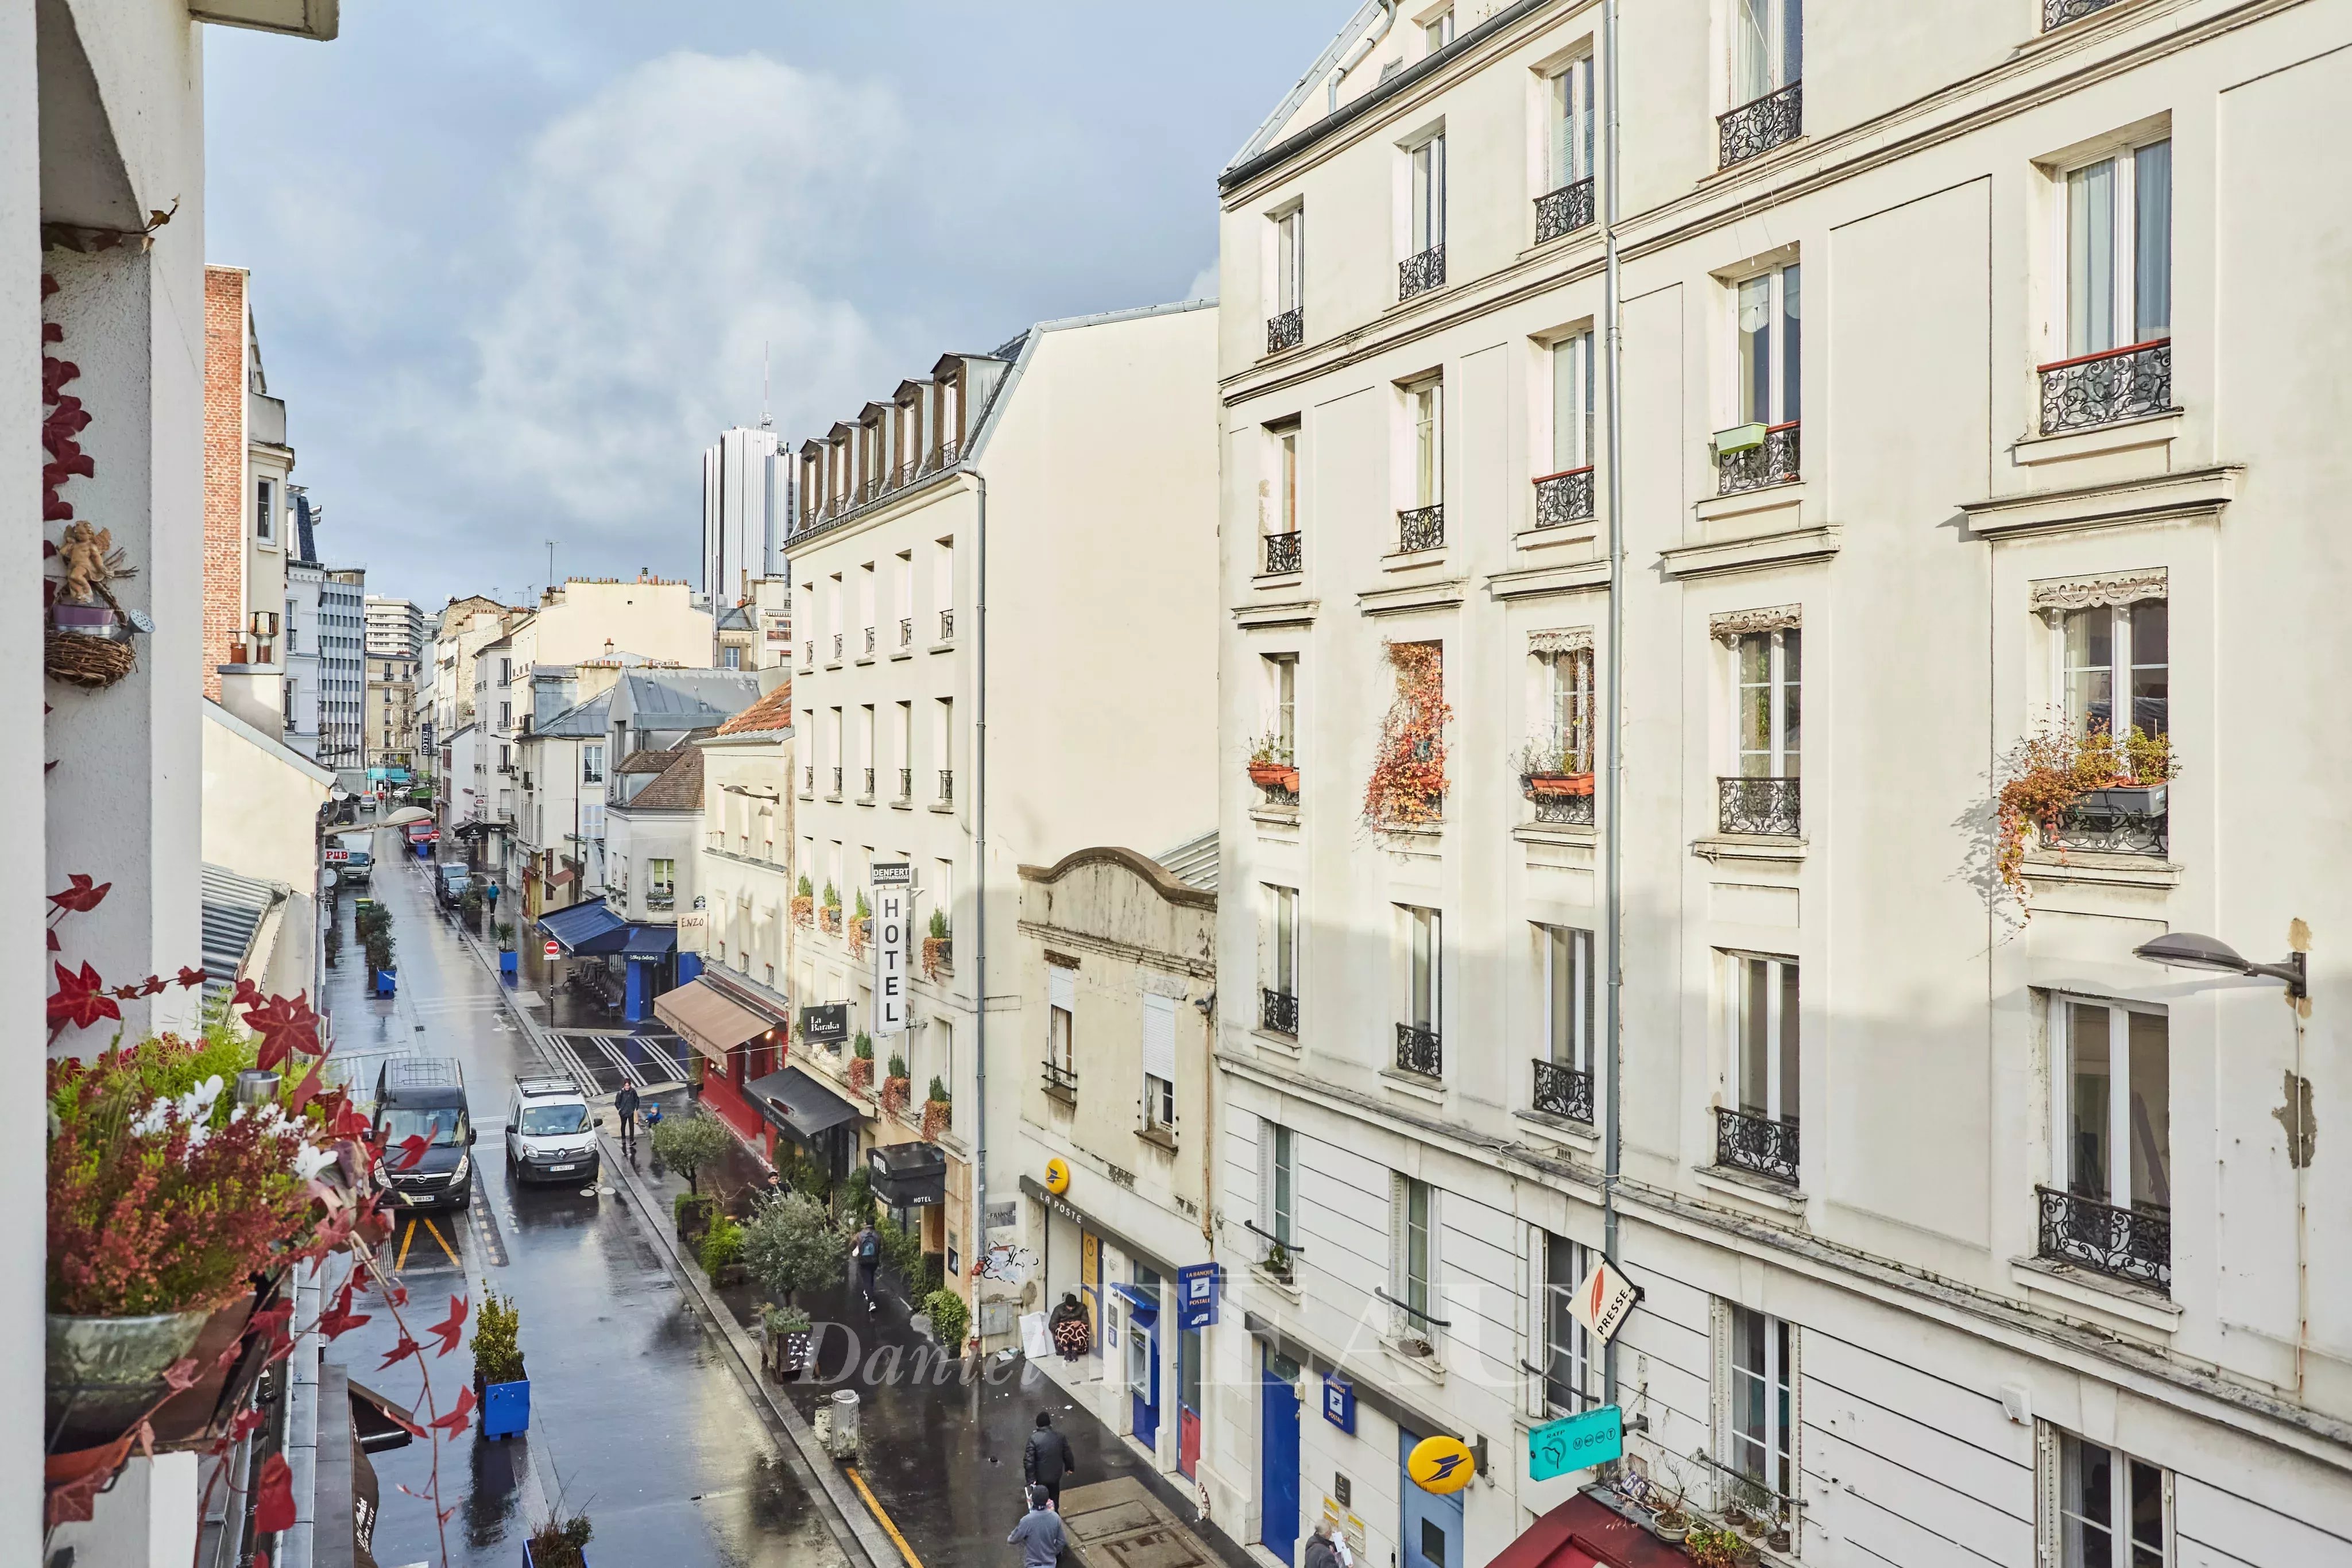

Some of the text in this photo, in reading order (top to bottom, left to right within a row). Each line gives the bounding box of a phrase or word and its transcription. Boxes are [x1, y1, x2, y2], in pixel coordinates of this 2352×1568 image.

[326, 851, 348, 860] PUB
[873, 868, 909, 876] DENFERT
[681, 917, 704, 928] ENZO
[885, 898, 899, 1022] HOTEL
[811, 1016, 821, 1024] La
[811, 1021, 840, 1032] Baraka
[1040, 1191, 1082, 1224] LA POSTE
[1193, 1269, 1214, 1277] BANQUE
[1189, 1298, 1210, 1306] POSTALE
[1597, 1289, 1628, 1335] PRESSE
[1331, 1381, 1346, 1395] BANQUE
[1328, 1411, 1344, 1425] POSTALE
[1546, 1429, 1565, 1439] RATP
